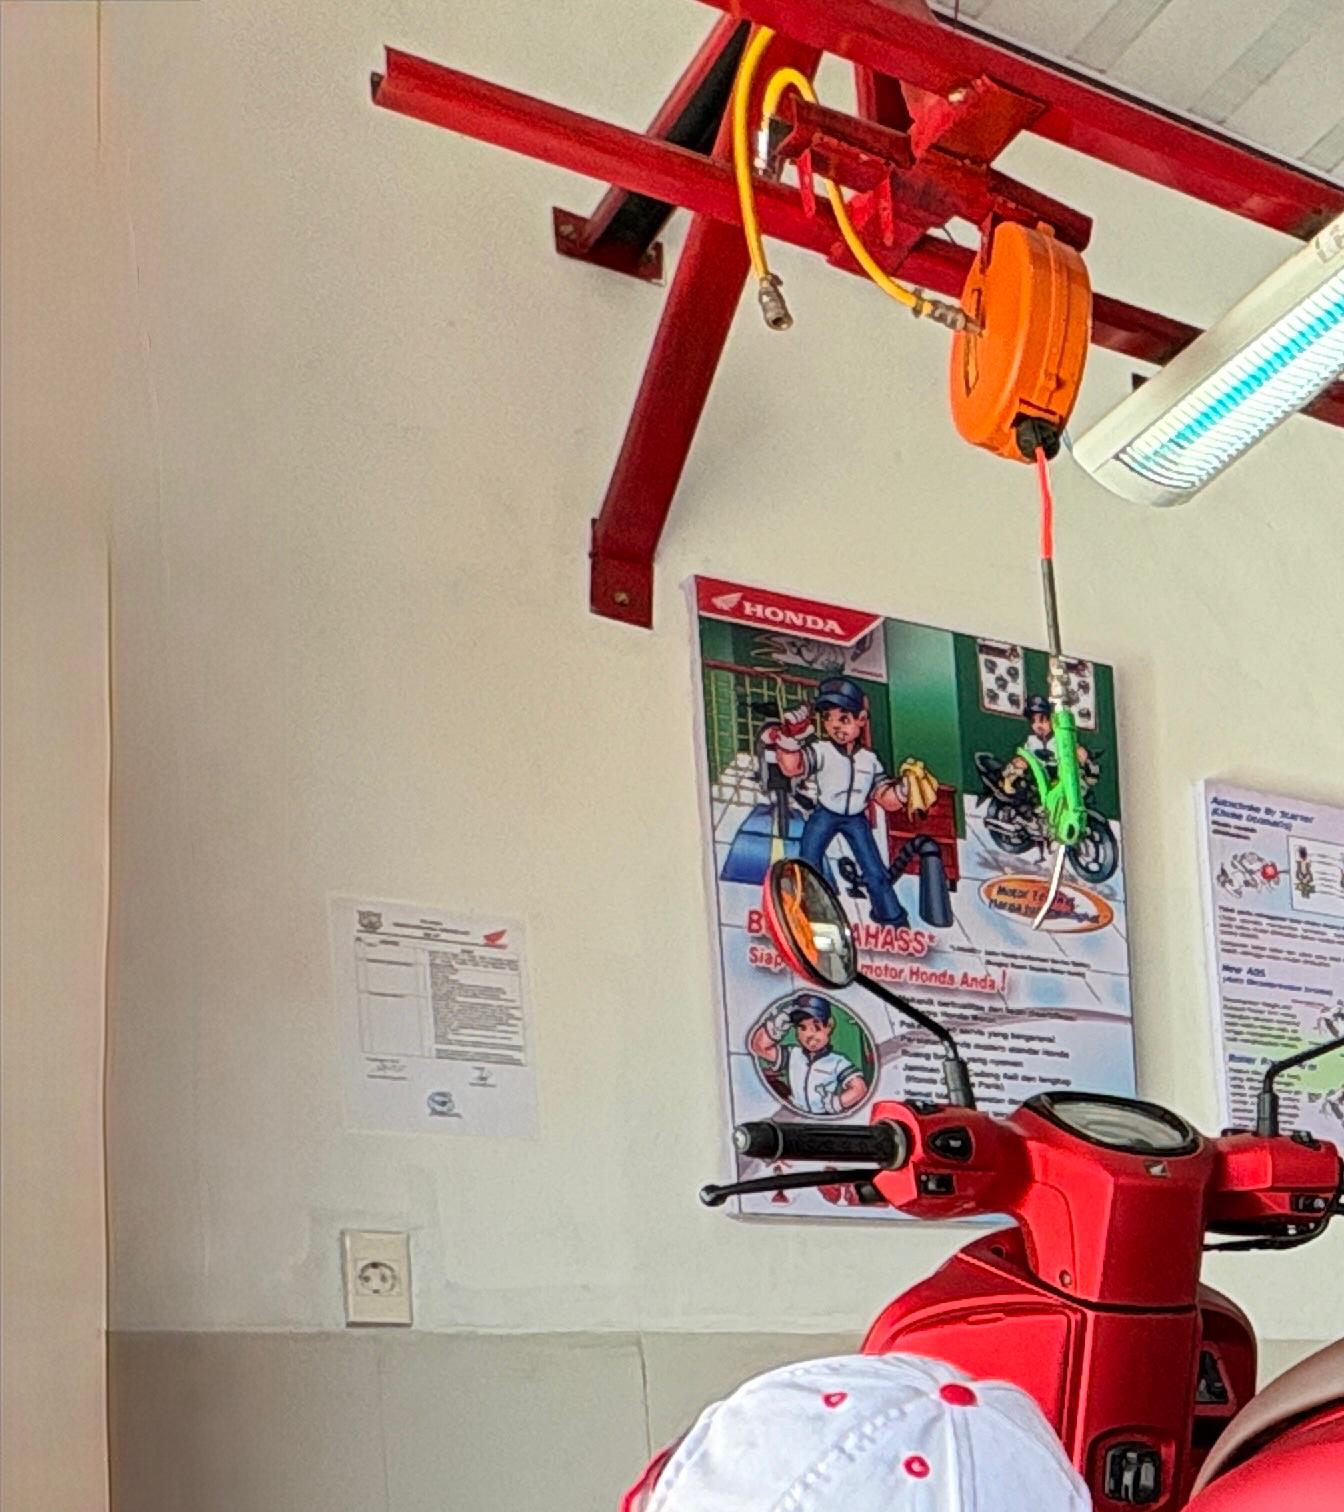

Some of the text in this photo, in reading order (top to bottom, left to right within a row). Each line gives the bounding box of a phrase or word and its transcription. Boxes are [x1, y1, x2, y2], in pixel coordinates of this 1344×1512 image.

[743, 601, 846, 635] HONDA
[861, 963, 905, 980] motor
[959, 971, 997, 990] Anda
